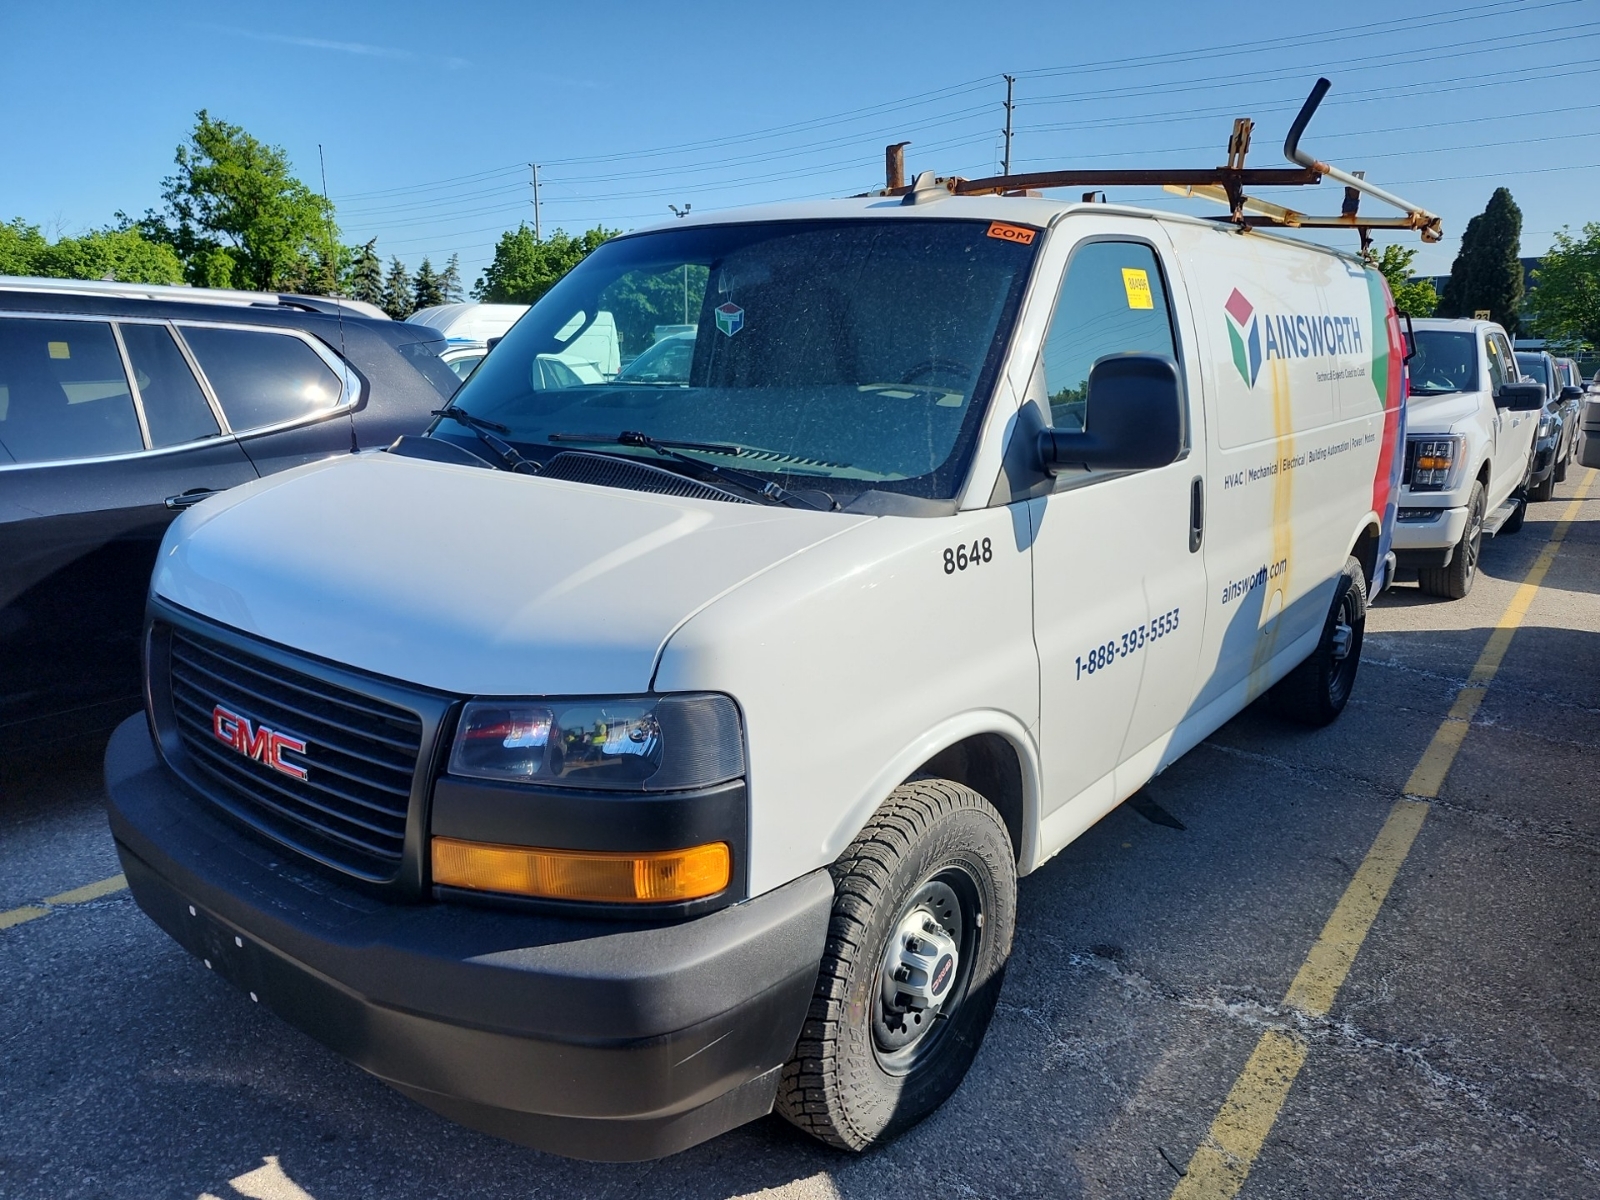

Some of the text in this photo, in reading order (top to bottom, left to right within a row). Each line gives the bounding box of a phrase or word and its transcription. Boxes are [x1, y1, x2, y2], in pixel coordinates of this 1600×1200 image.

[991, 226, 1031, 242] COM
[1265, 314, 1363, 360] AINSWORTH
[1224, 471, 1243, 490] HVAC
[1248, 460, 1279, 482] Mechanical
[1282, 453, 1305, 472] Electrical
[1309, 448, 1327, 463] Building
[1327, 441, 1349, 455] Automation
[1352, 438, 1362, 448] Power
[943, 537, 993, 575] 8648
[1222, 558, 1287, 604] ainsworth.com
[1075, 608, 1180, 681] 1-888-393-5553
[213, 704, 308, 781] GMC
